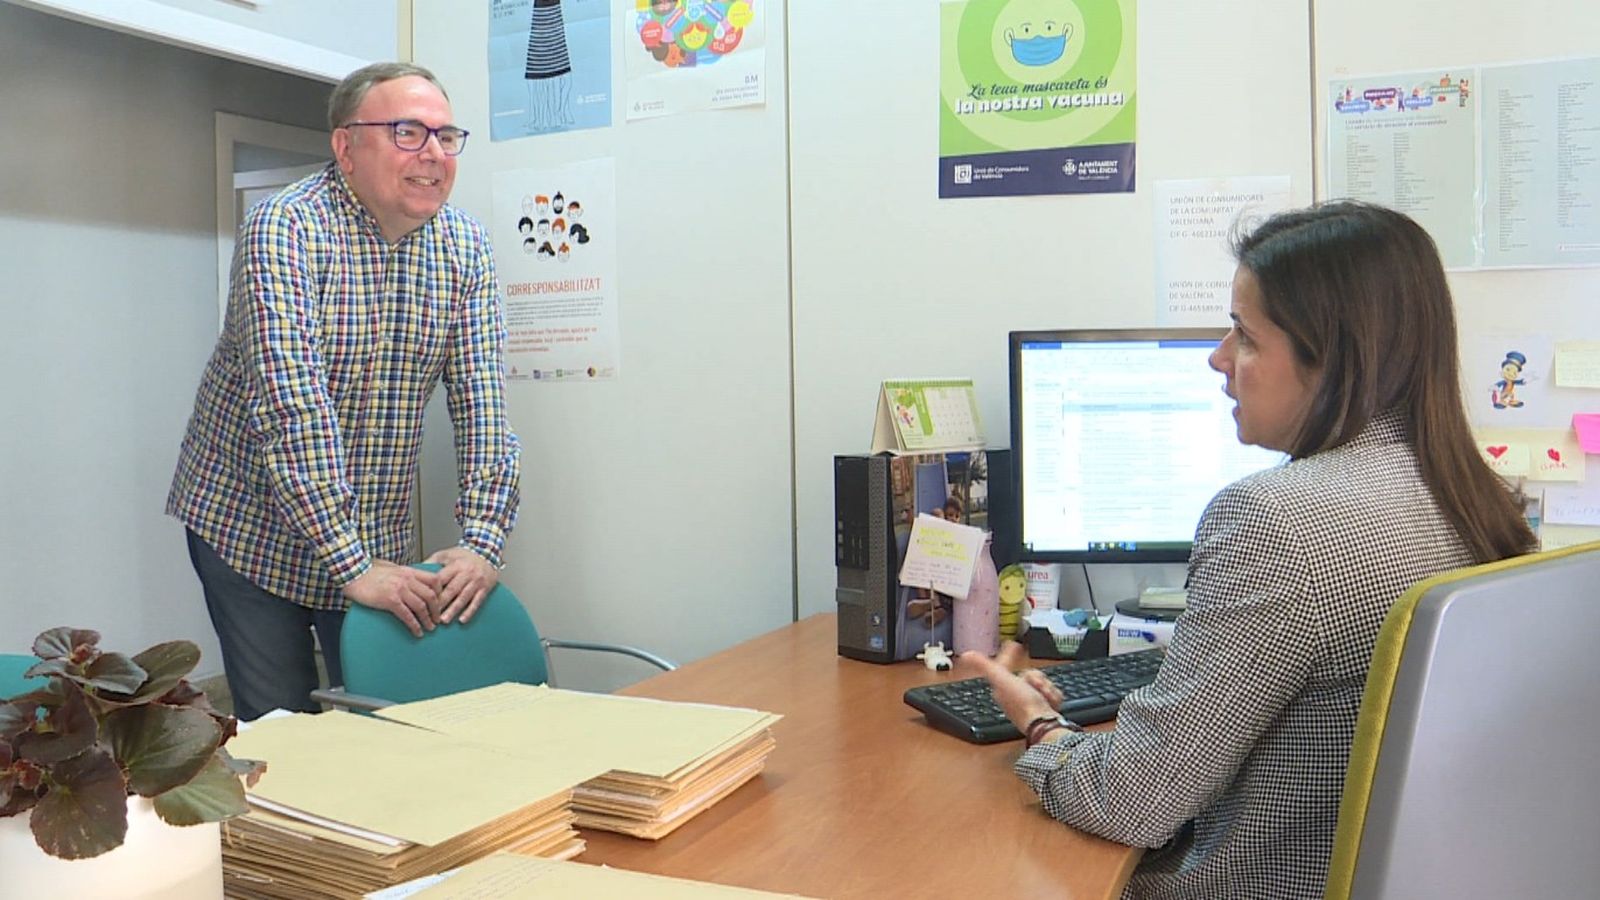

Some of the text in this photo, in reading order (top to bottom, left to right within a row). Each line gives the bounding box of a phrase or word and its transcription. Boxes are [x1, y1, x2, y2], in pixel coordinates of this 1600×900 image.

[967, 75, 1108, 99] La teua mascareta és
[955, 90, 1124, 115] la nostra vacuna
[1169, 193, 1264, 204] UNIÓN DE CONSUMIDORES
[1191, 206, 1234, 214] COMUNITAT
[1170, 217, 1214, 225] VALENCIANA
[1169, 280, 1193, 289] UNIÓN
[1027, 570, 1049, 581] urea
